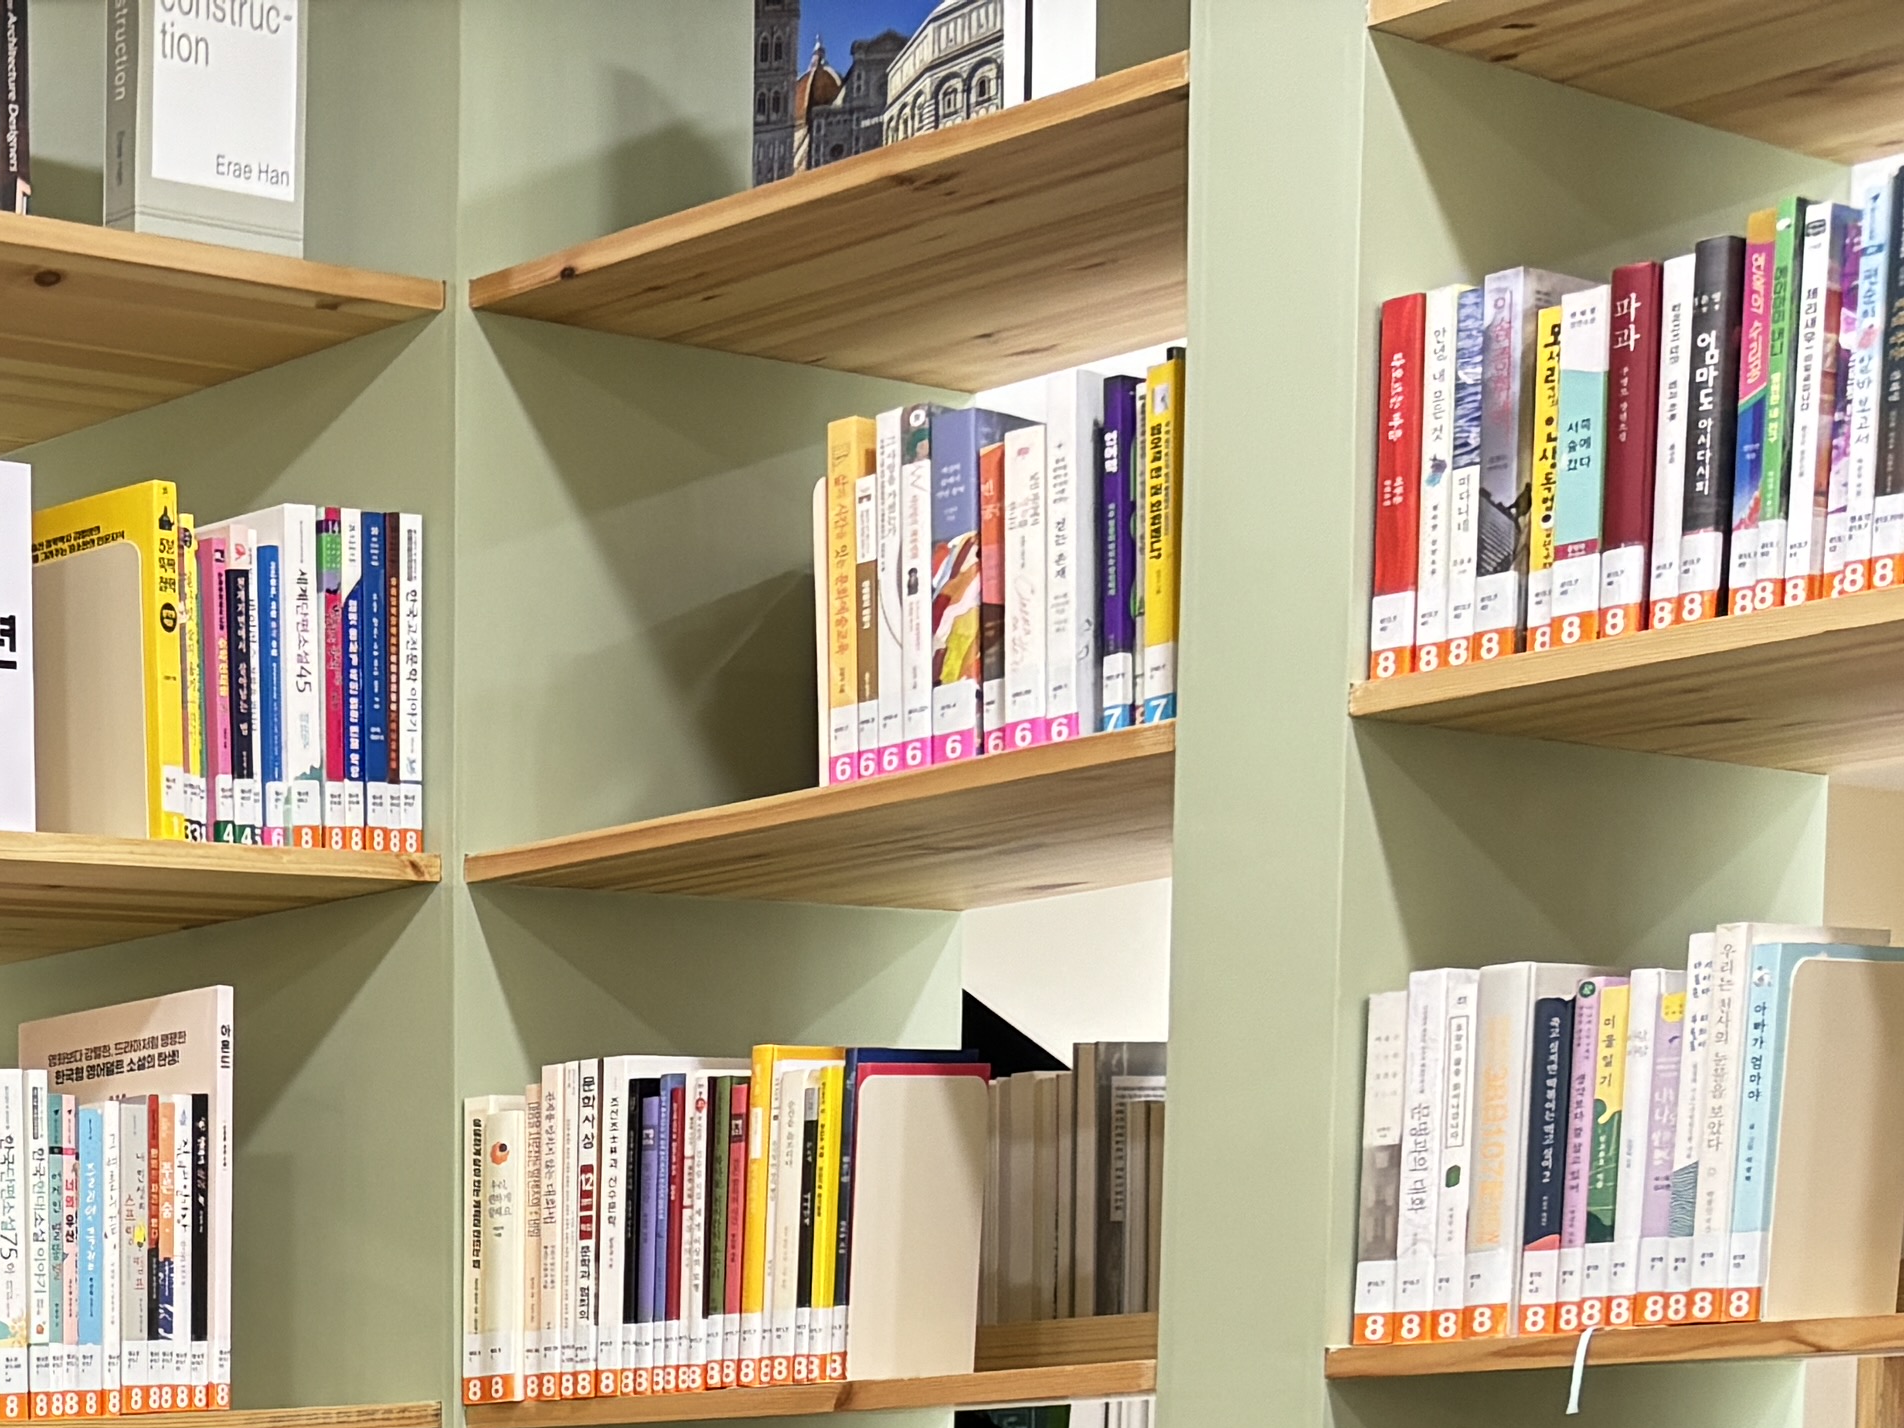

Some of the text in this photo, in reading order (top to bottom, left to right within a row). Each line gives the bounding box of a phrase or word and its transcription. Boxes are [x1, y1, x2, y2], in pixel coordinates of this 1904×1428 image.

[160, 24, 211, 68] tion
[215, 154, 291, 187] Erae Han
[1612, 292, 1642, 353] 파과
[1696, 331, 1721, 497] 엄마도 아시다시피
[1561, 615, 1582, 644] 8
[1015, 721, 1033, 747] 6
[1748, 1003, 1767, 1103] 아빠가 엄마야
[580, 1075, 596, 1151] 문학사상
[1729, 1290, 1750, 1318] 8
